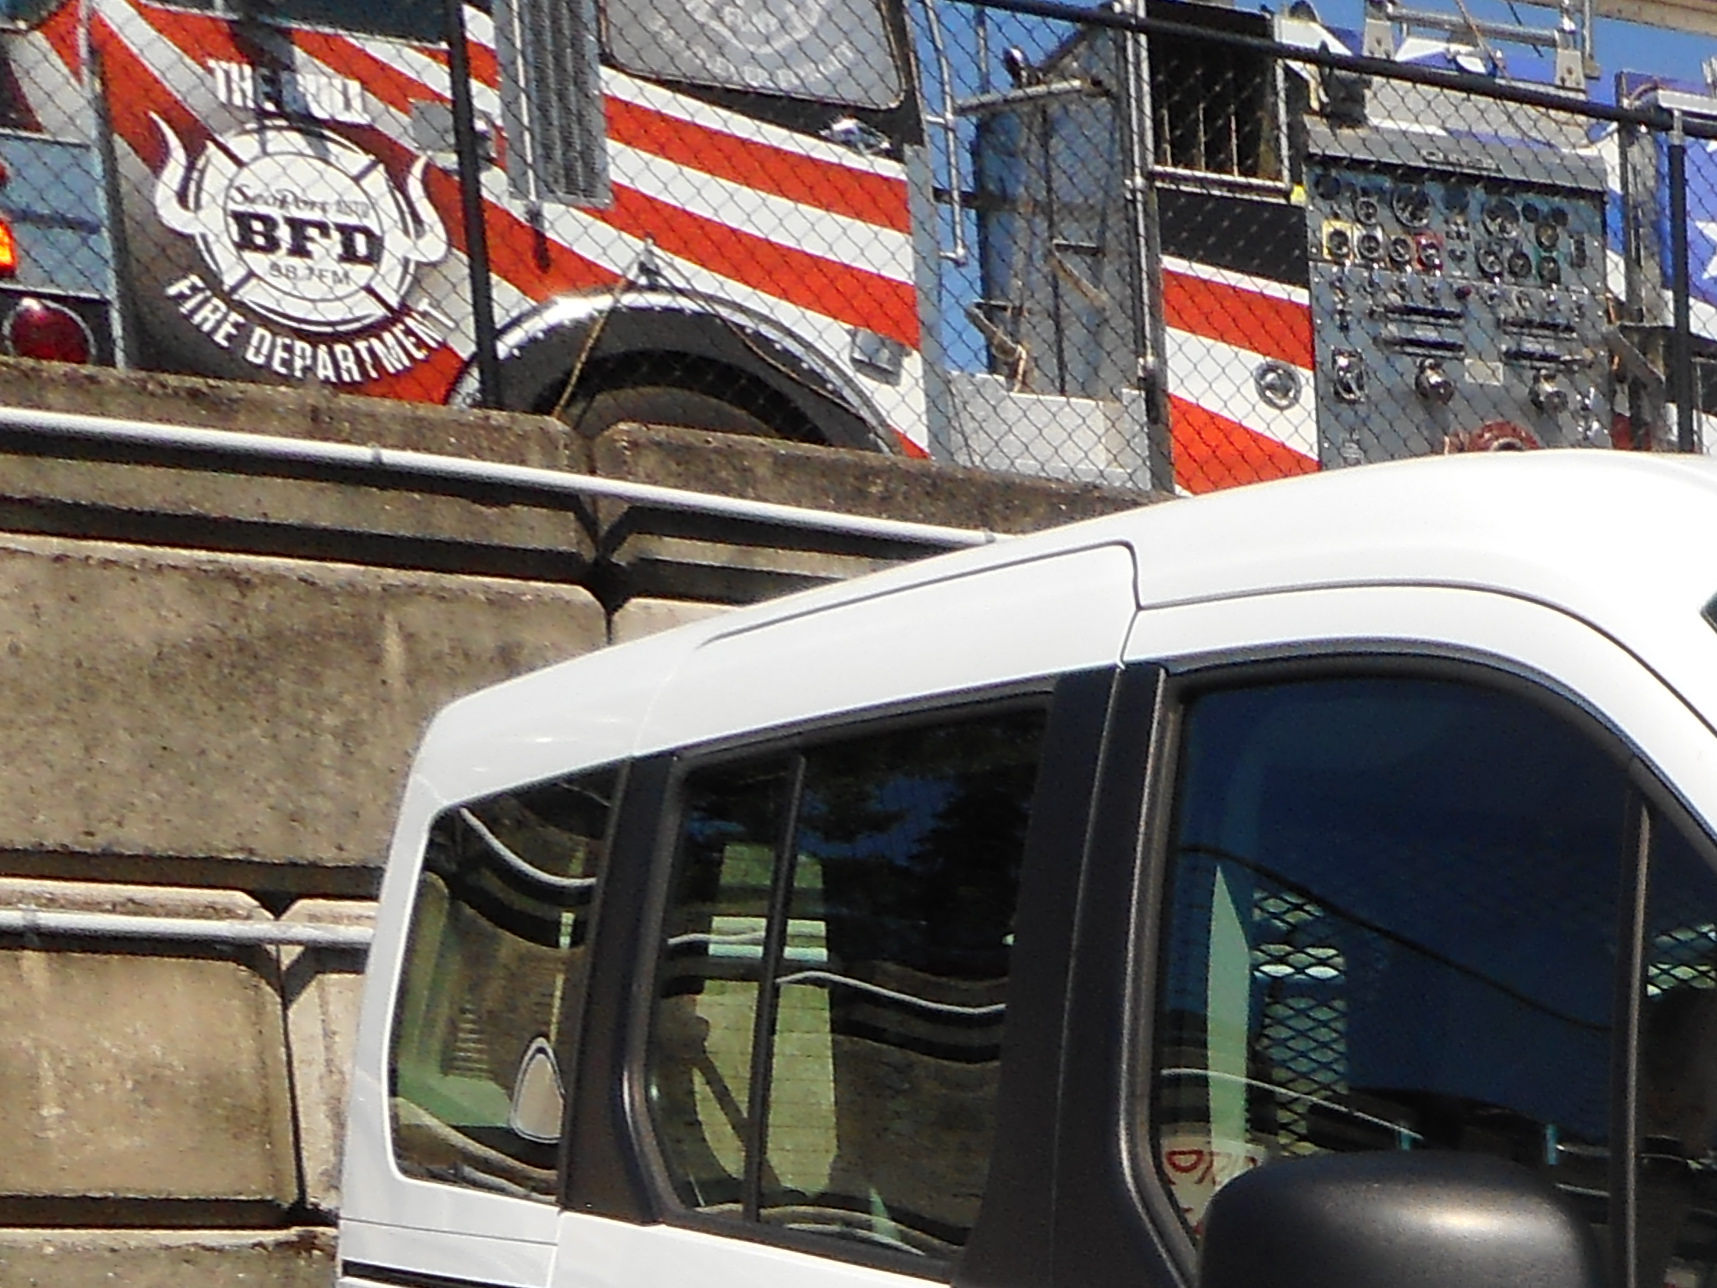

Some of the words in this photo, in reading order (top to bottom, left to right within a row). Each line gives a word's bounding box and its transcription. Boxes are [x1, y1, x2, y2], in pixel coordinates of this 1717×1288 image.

[230, 209, 384, 267] BFD
[165, 274, 247, 348] FIRE
[243, 298, 457, 383] DEPARTMENT
